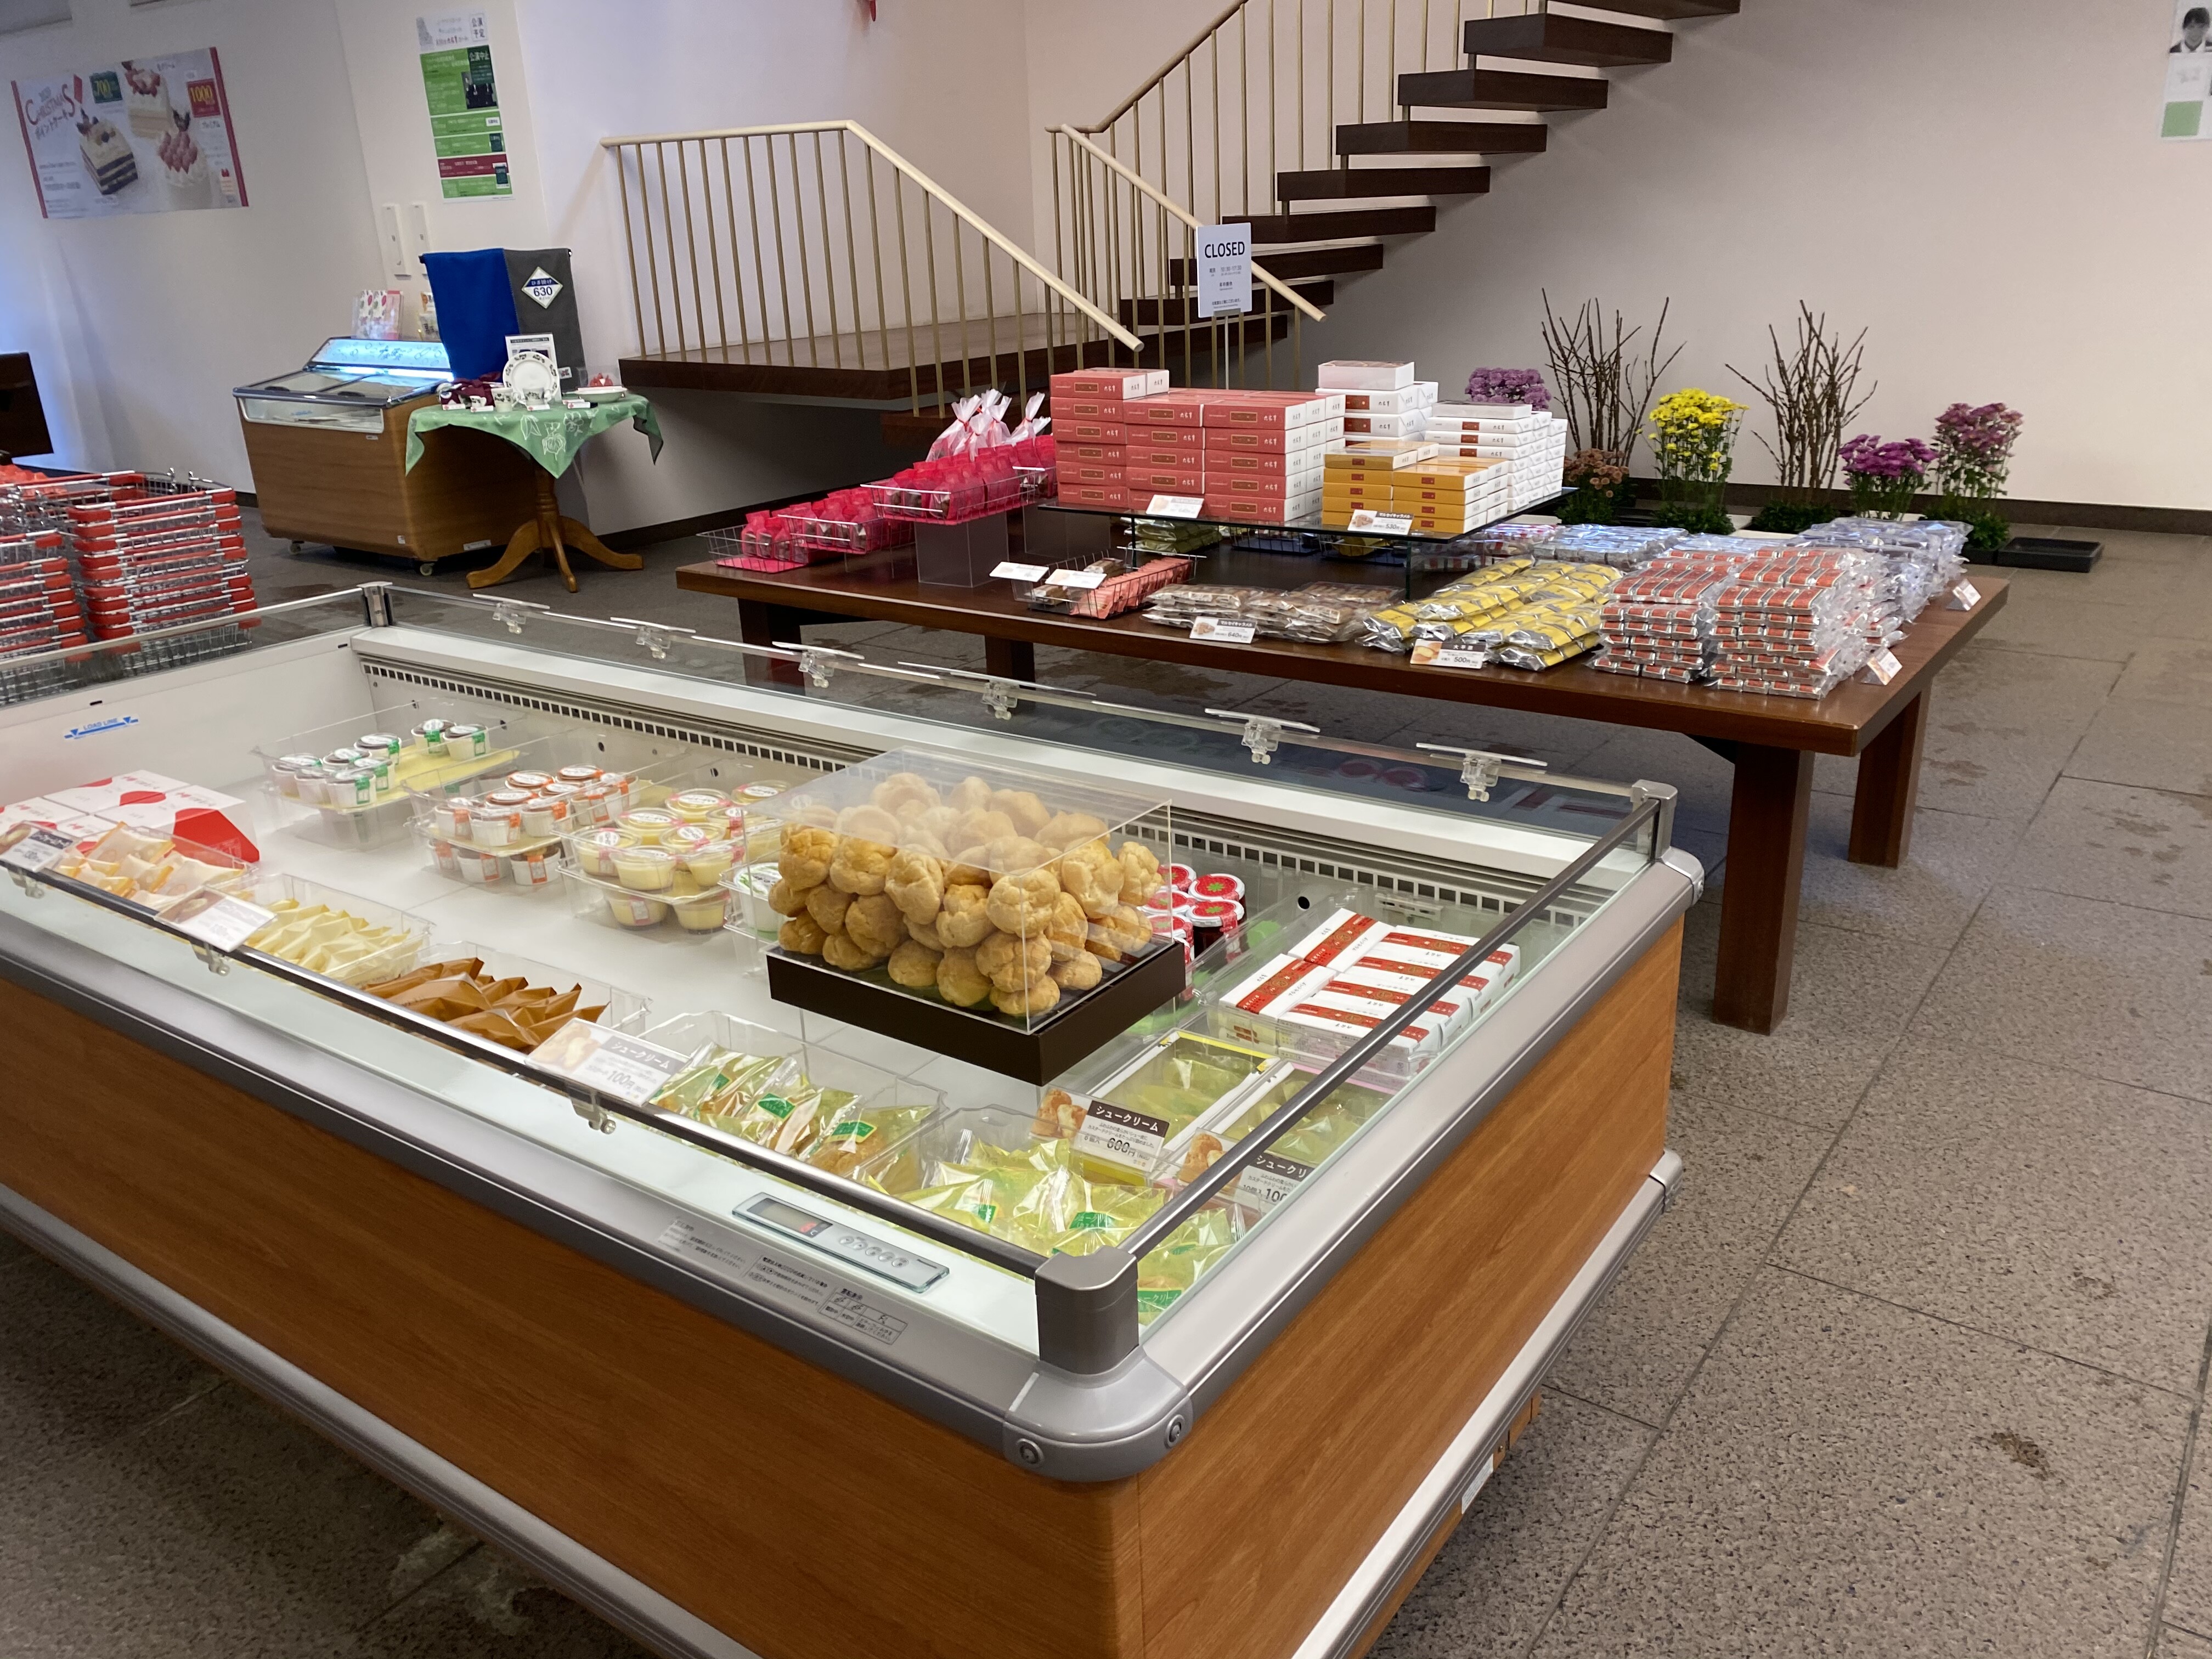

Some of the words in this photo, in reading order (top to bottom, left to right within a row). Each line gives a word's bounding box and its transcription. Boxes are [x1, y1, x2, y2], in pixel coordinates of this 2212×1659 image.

[1205, 241, 1245, 258] CLOSED
[533, 286, 552, 297] 630
[611, 1042, 670, 1069] シュークリーム
[1096, 1106, 1158, 1132] シュークリーム
[1256, 1155, 1306, 1178] シュークリ
